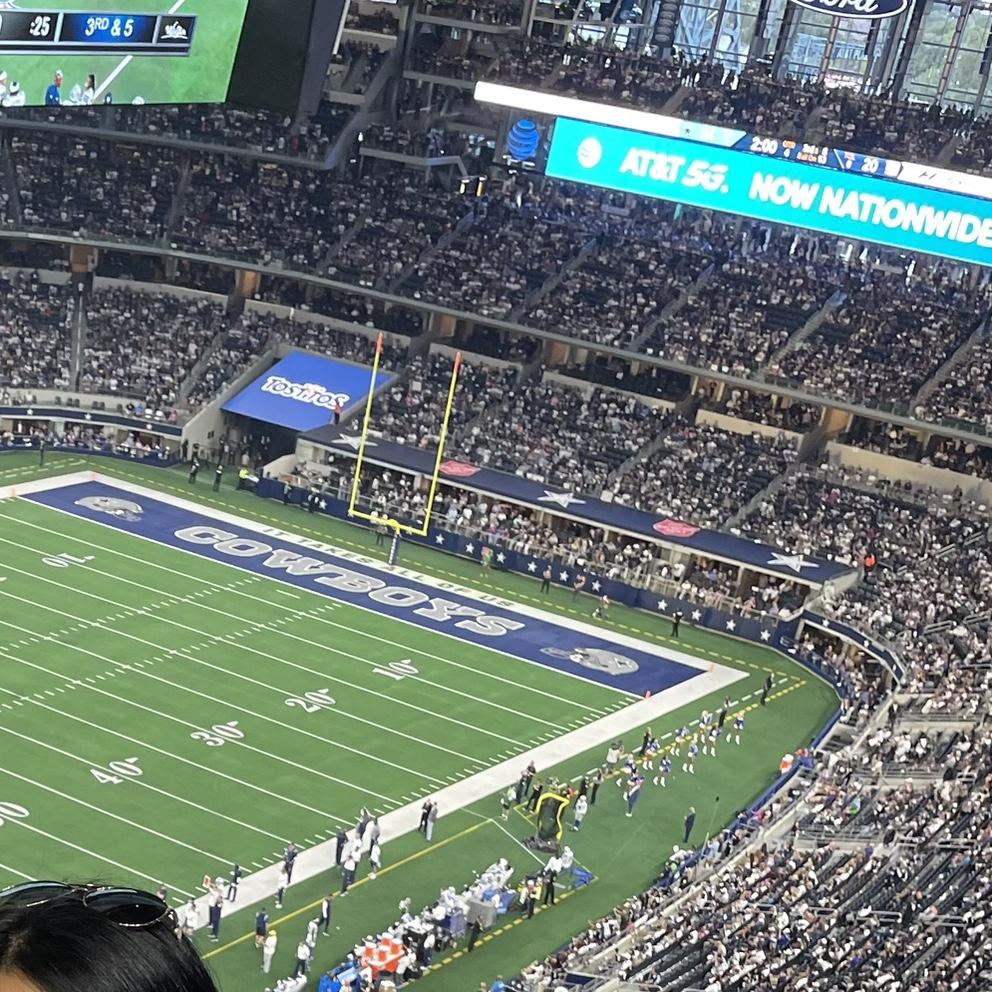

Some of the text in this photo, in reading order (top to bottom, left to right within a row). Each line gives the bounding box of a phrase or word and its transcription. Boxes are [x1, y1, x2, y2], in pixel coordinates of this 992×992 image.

[30, 16, 51, 36] :25
[85, 17, 133, 37] 3RD & 5
[750, 136, 778, 154] 2:00
[619, 147, 686, 183] AT&T
[748, 172, 820, 210] NOW
[818, 186, 992, 248] NATIONWIDE
[42, 552, 86, 568] 10
[173, 525, 526, 636] COWBOYS
[372, 659, 419, 681] 10
[284, 690, 336, 713] 20
[190, 722, 244, 747] 30
[90, 759, 143, 784] 40
